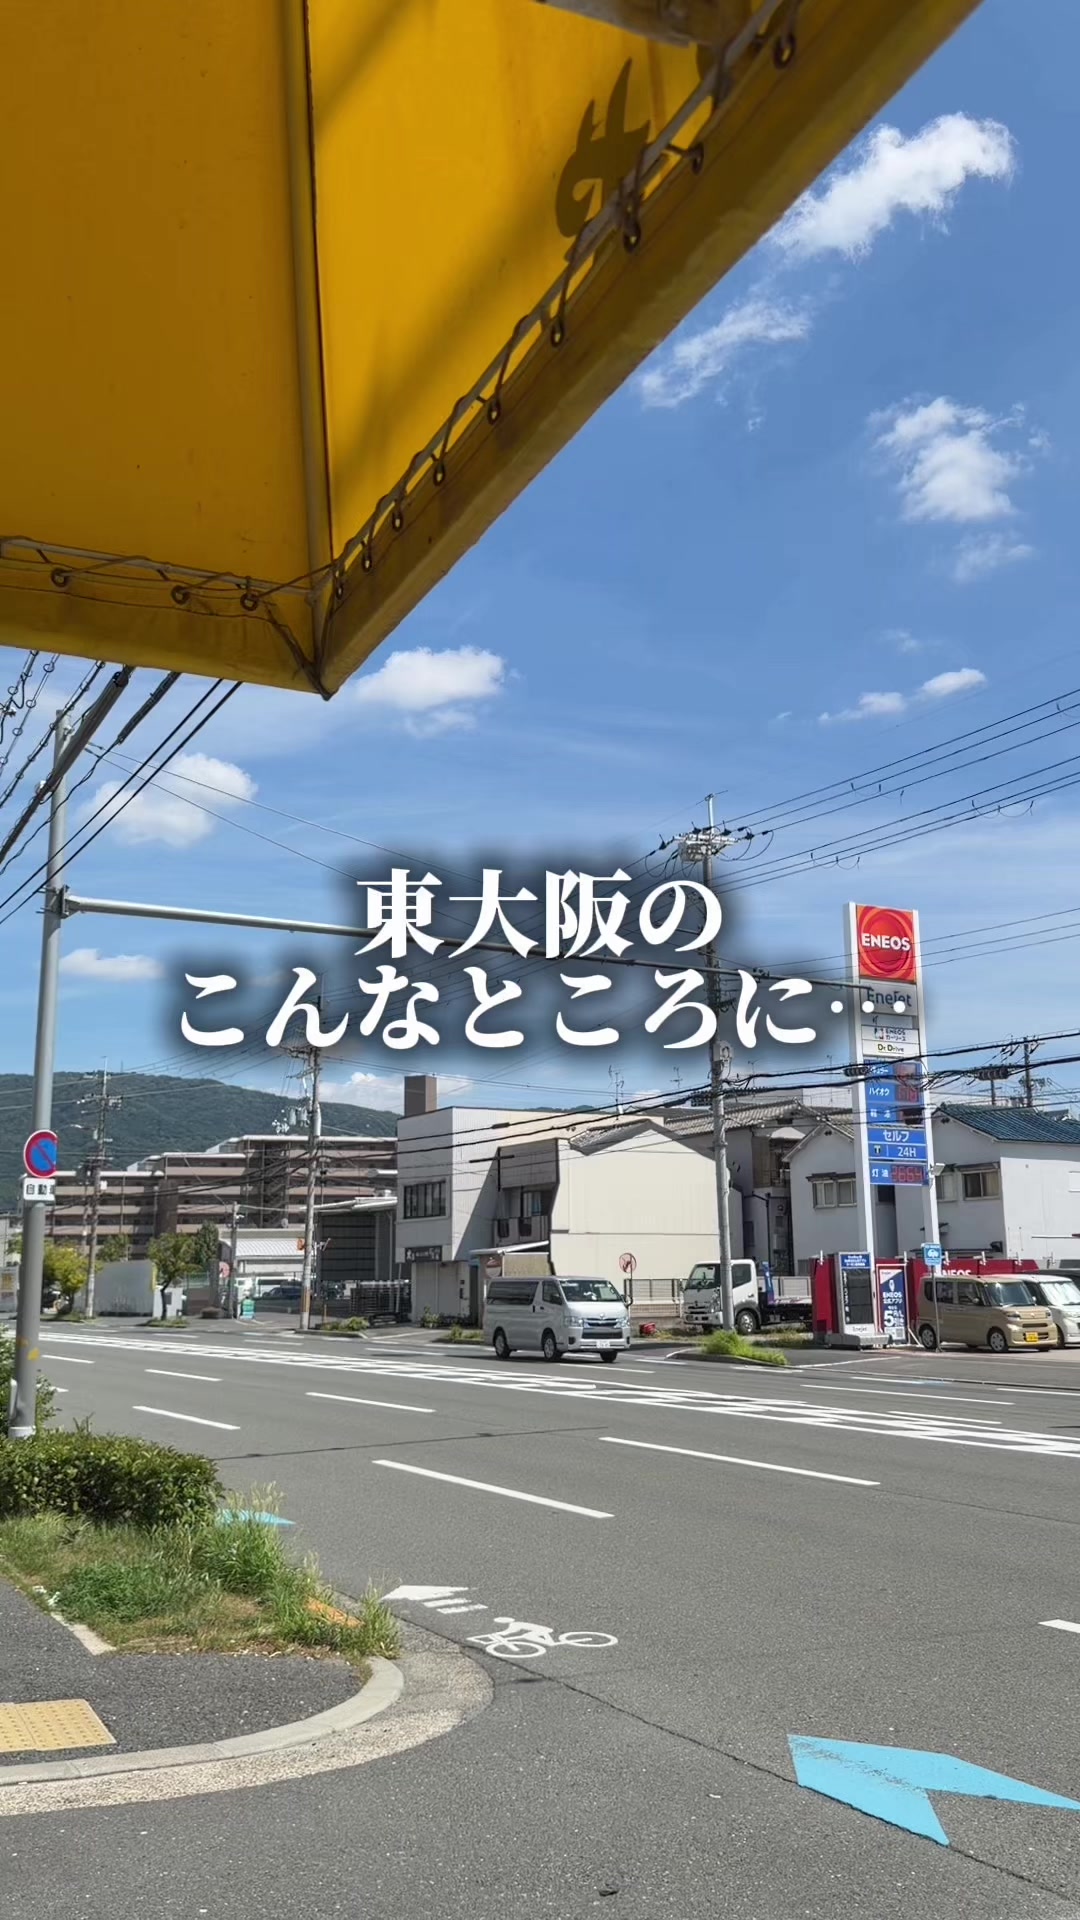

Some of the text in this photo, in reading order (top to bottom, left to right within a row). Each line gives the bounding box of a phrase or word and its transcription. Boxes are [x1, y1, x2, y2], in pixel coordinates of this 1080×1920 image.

[861, 933, 911, 951] ENEOS
[869, 1087, 890, 1096] ハイオク
[883, 1129, 910, 1142] セルフ
[897, 1147, 917, 1157] 24H
[872, 1168, 889, 1177] 灯油
